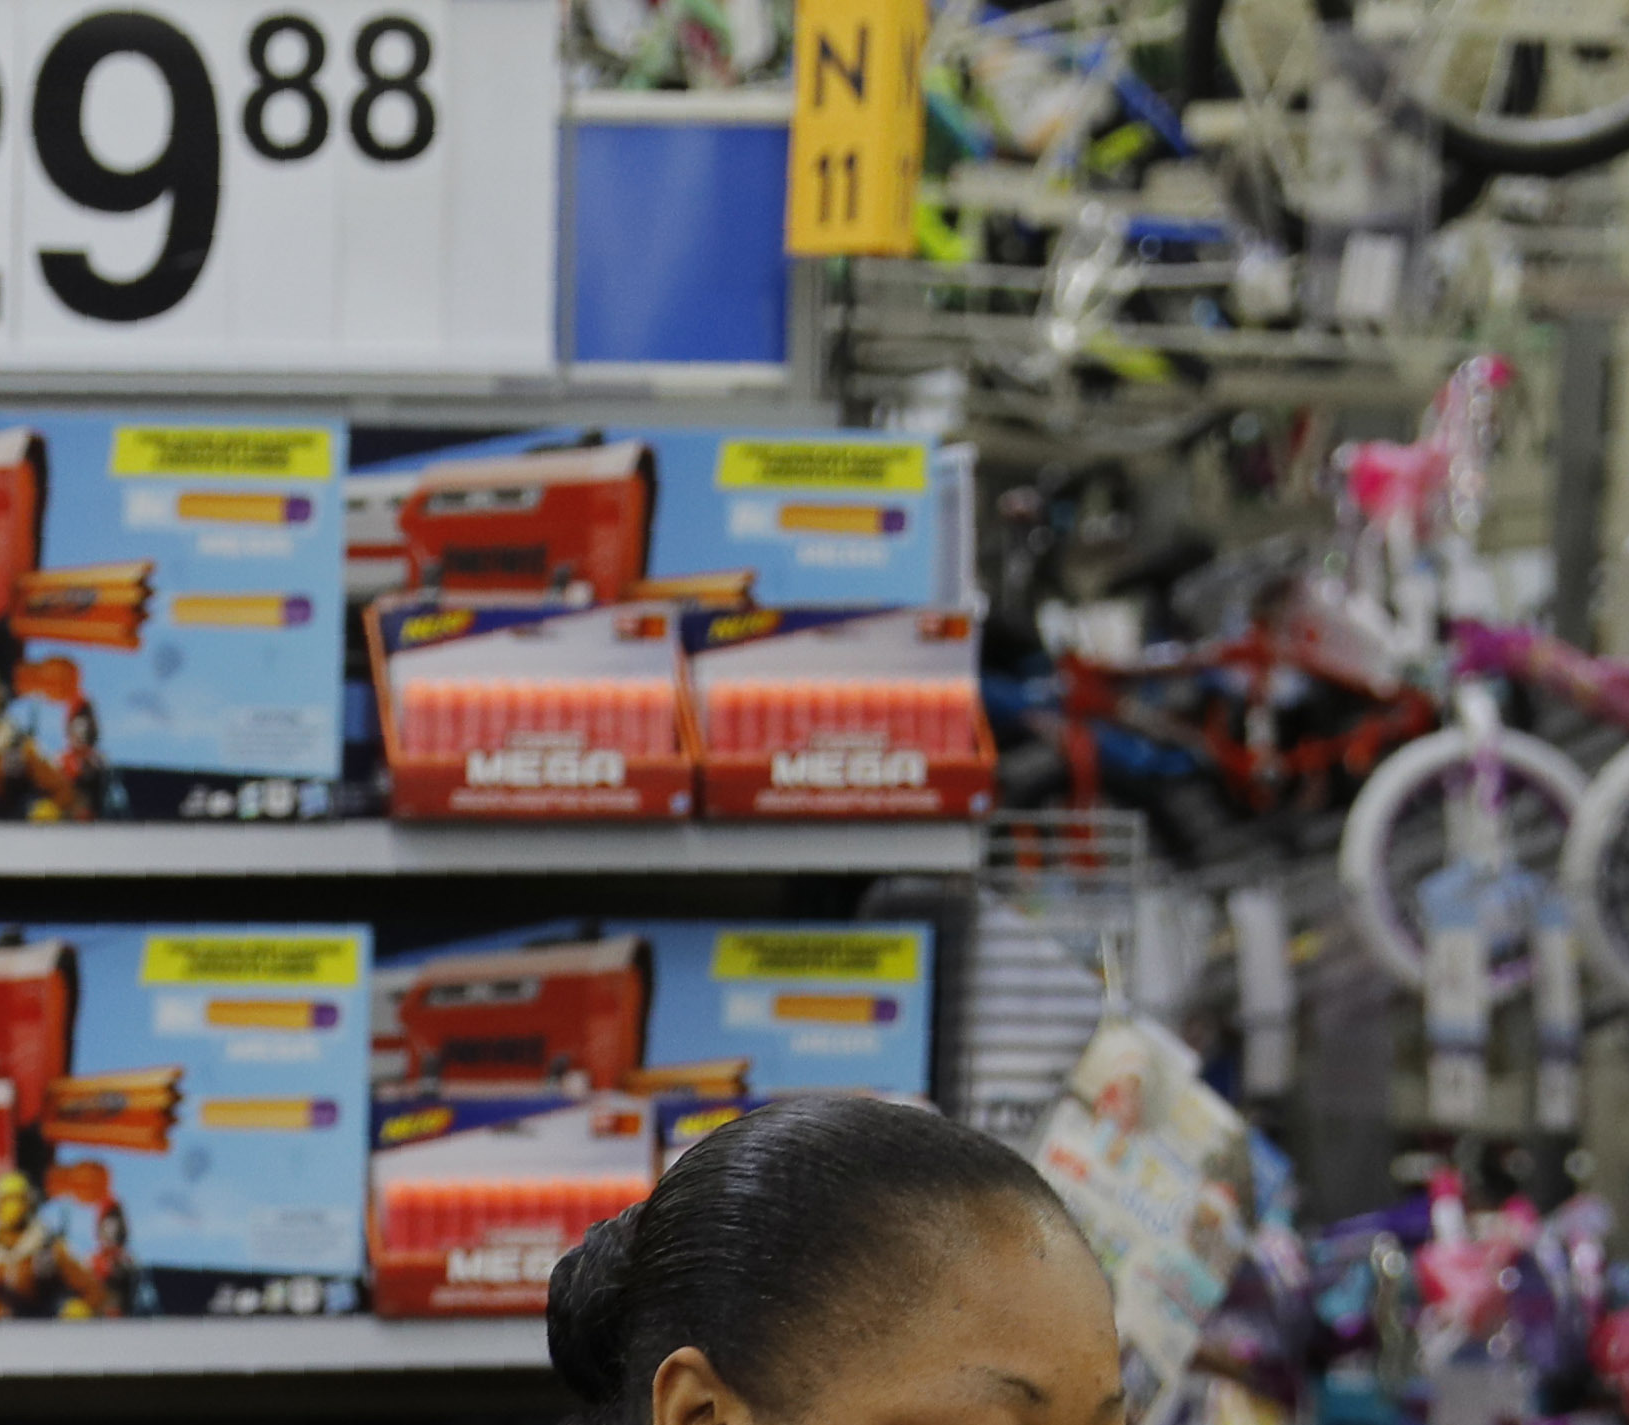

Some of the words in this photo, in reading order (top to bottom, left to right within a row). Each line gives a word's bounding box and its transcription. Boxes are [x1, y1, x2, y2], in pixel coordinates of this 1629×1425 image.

[813, 25, 868, 110] N
[814, 151, 860, 228] 11
[467, 749, 627, 790] MEGA
[771, 749, 929, 790] MEGA
